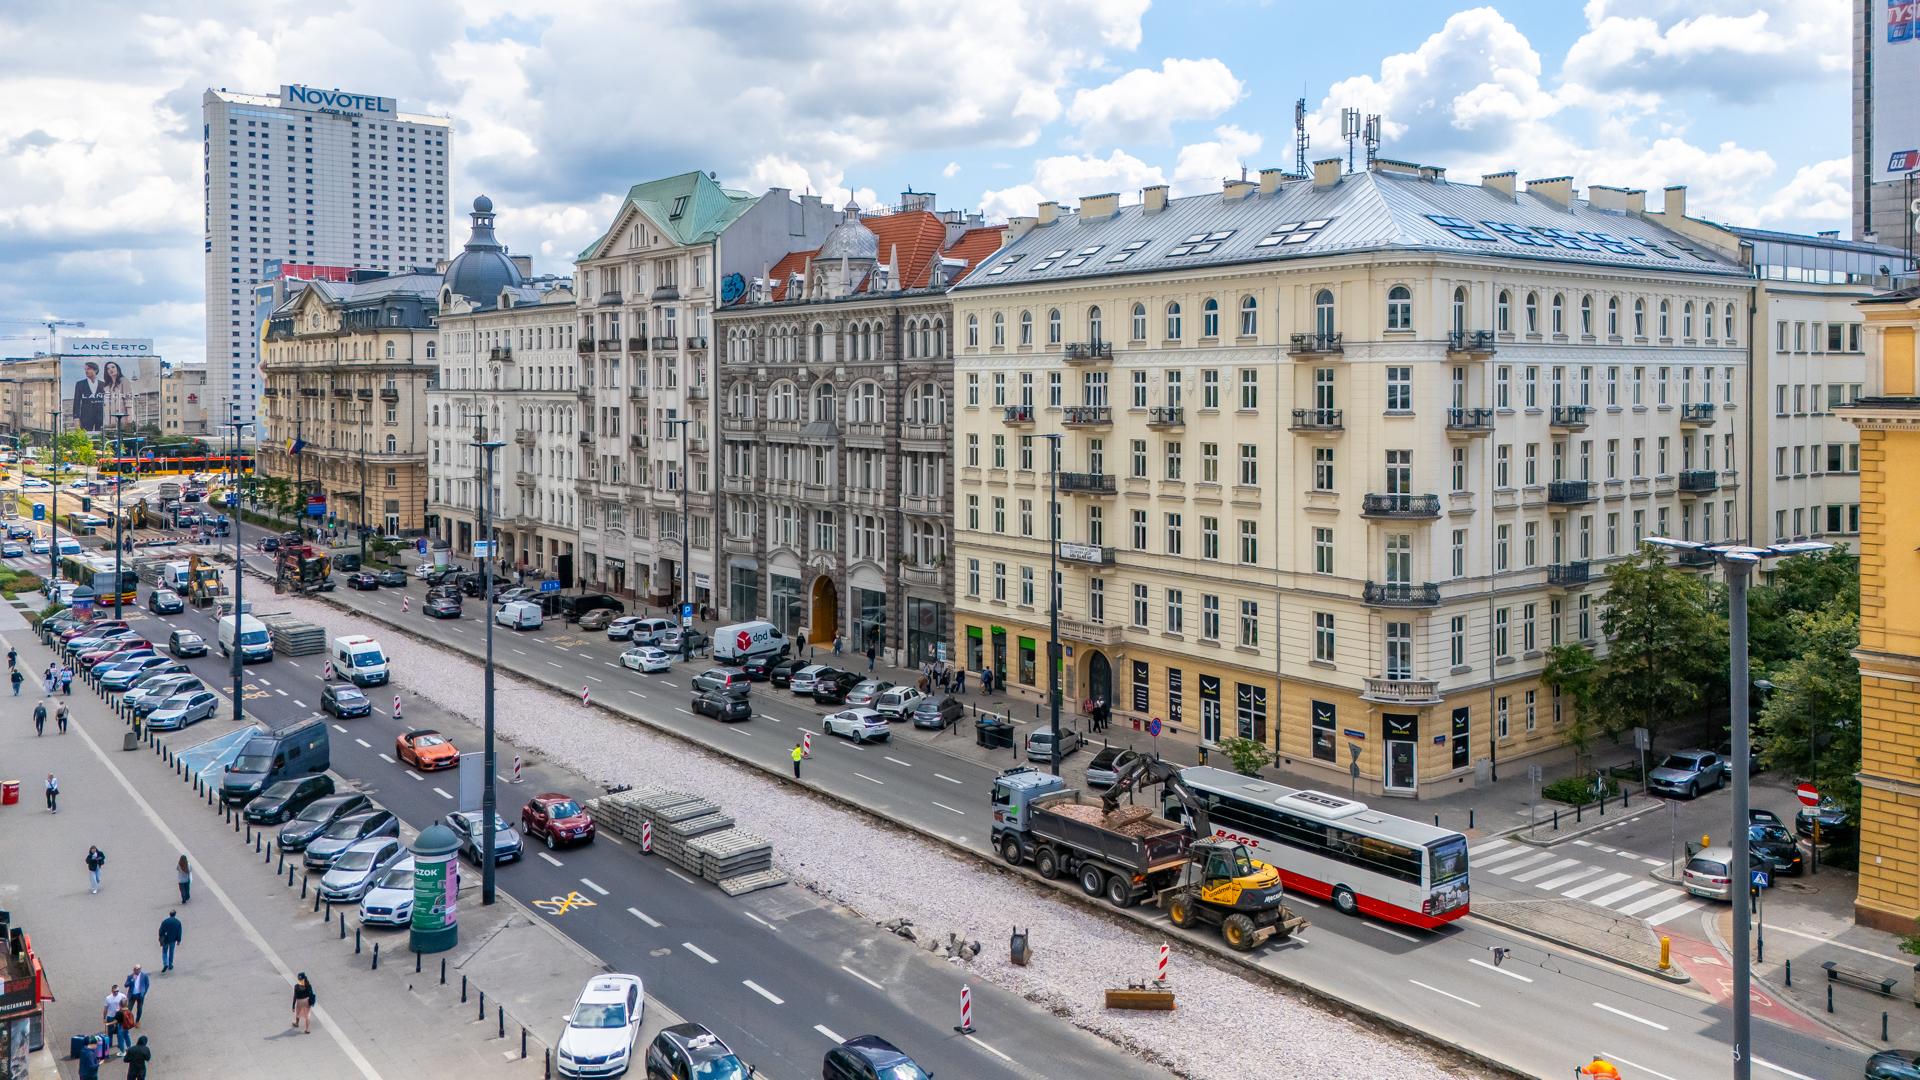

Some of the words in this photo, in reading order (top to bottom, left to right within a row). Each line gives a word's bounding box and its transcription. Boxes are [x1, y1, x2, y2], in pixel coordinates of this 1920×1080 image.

[289, 86, 390, 112] NOVOTEL
[752, 630, 768, 644] dpd
[1215, 829, 1260, 848] BAGS
